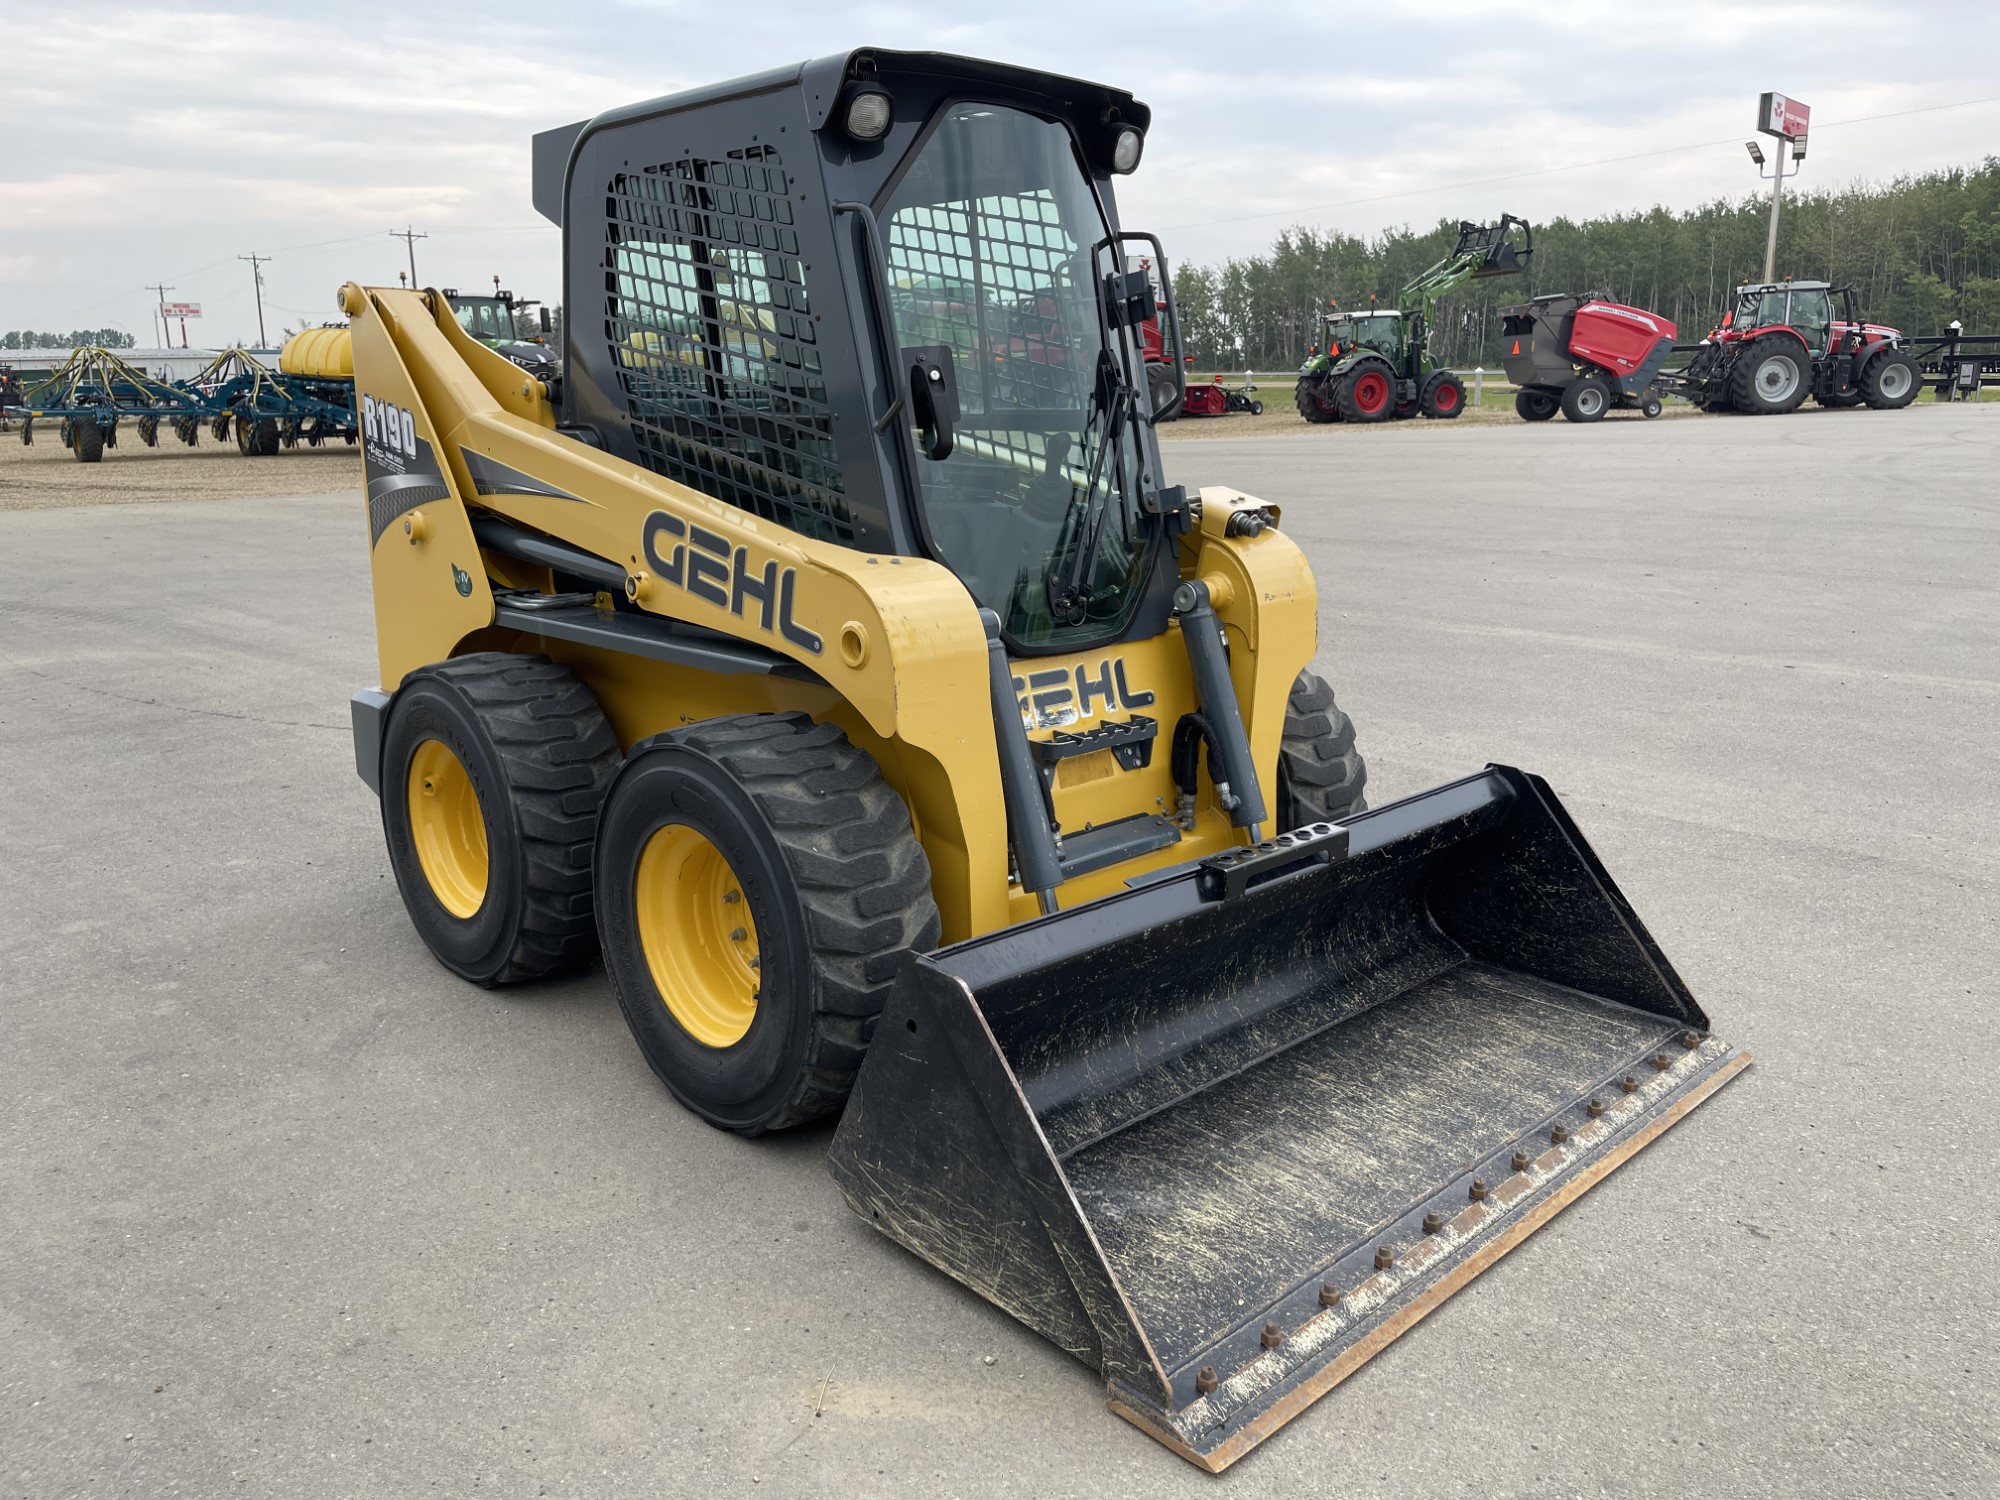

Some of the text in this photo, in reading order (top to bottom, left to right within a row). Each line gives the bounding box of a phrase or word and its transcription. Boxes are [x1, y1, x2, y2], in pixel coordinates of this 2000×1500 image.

[362, 393, 417, 460] R190
[642, 509, 824, 656] GEHL
[1012, 656, 1155, 733] EHL
